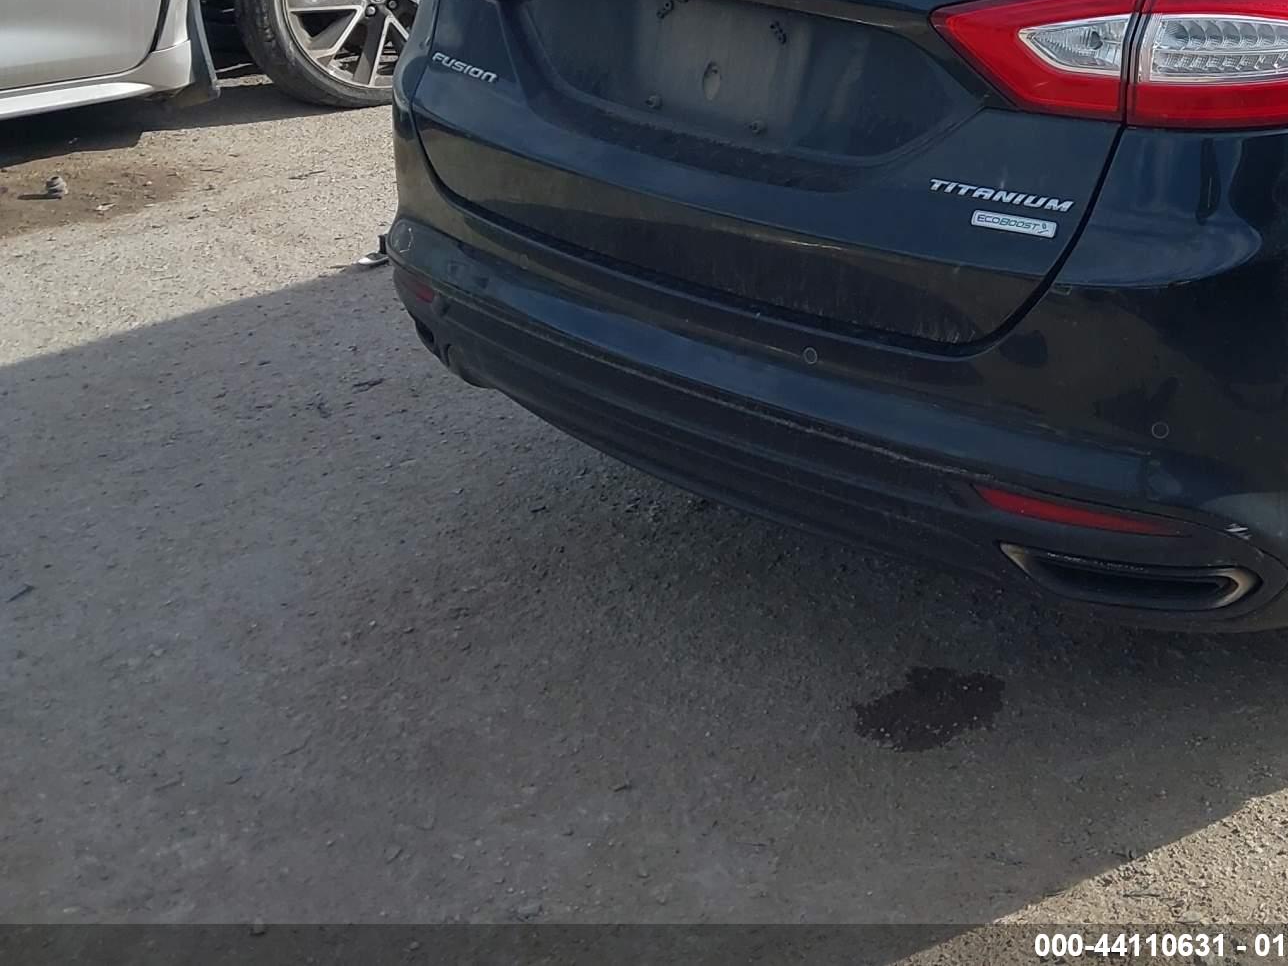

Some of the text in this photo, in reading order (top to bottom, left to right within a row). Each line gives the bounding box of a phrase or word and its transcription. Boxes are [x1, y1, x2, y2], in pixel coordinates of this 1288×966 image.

[432, 52, 498, 83] FUSION
[930, 178, 1074, 212] TITANIUM
[976, 214, 1040, 230] ECOBOOST
